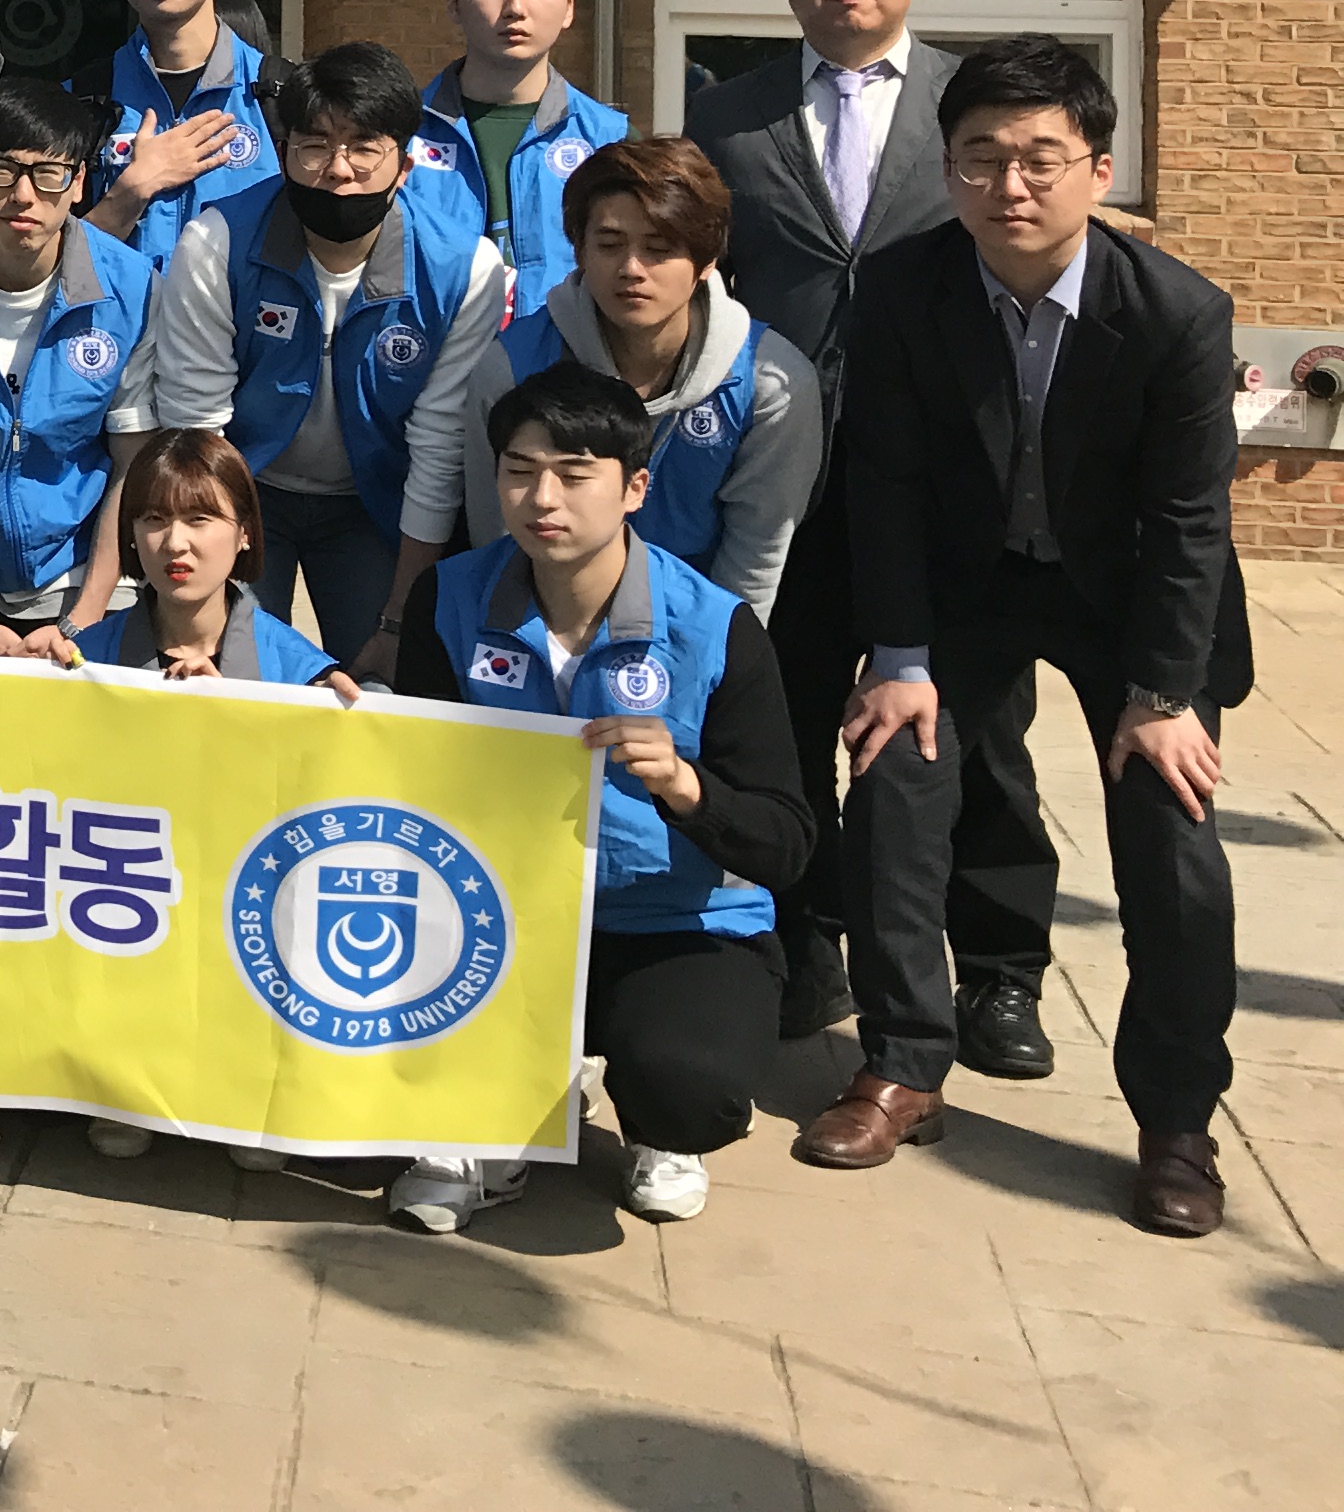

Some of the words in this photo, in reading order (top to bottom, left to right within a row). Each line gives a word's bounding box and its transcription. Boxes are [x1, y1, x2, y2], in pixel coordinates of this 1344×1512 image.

[333, 869, 400, 895] 서영
[237, 908, 321, 1027] SEOYEONG
[331, 1016, 393, 1041] 1978
[398, 936, 499, 1033] UNIVERSITY
